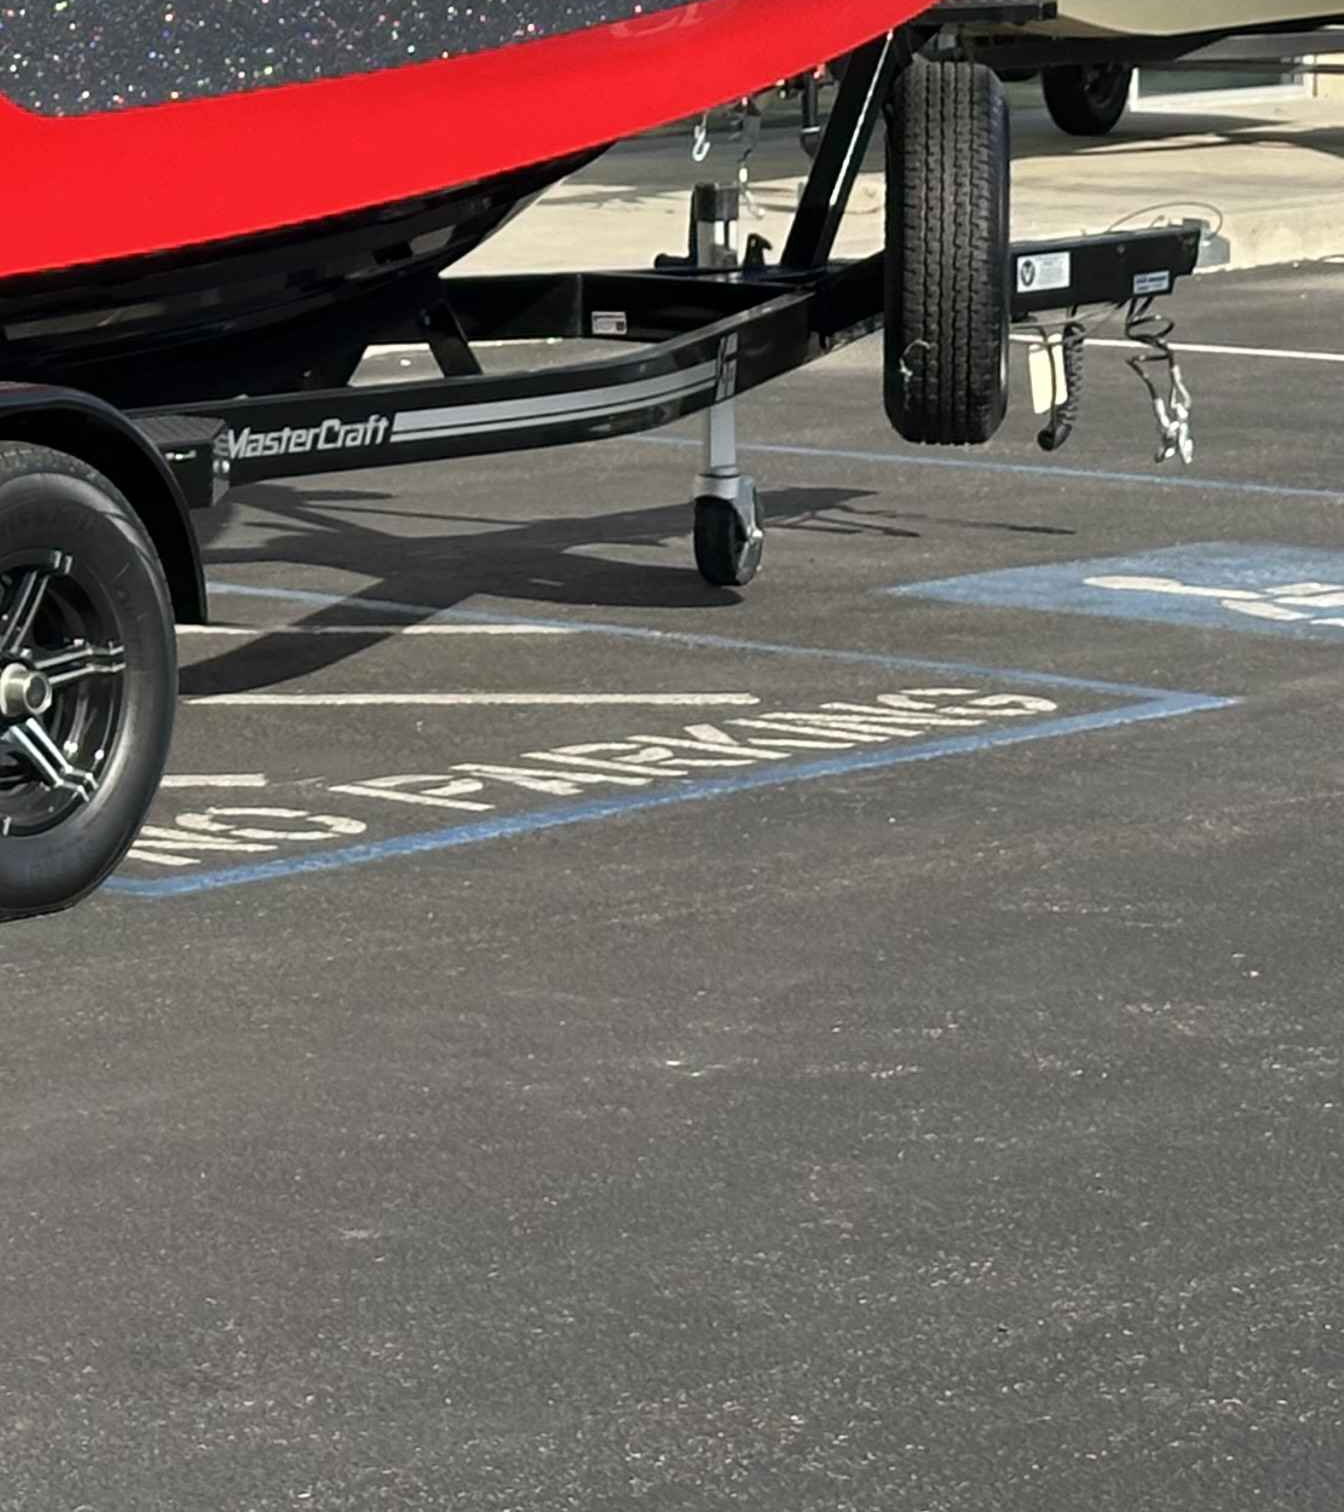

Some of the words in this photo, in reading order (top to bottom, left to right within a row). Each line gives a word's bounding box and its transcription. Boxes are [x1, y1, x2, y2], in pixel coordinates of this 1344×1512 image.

[227, 413, 389, 459] MasterCraft
[126, 806, 368, 867] NO
[328, 687, 1058, 812] PARKING
